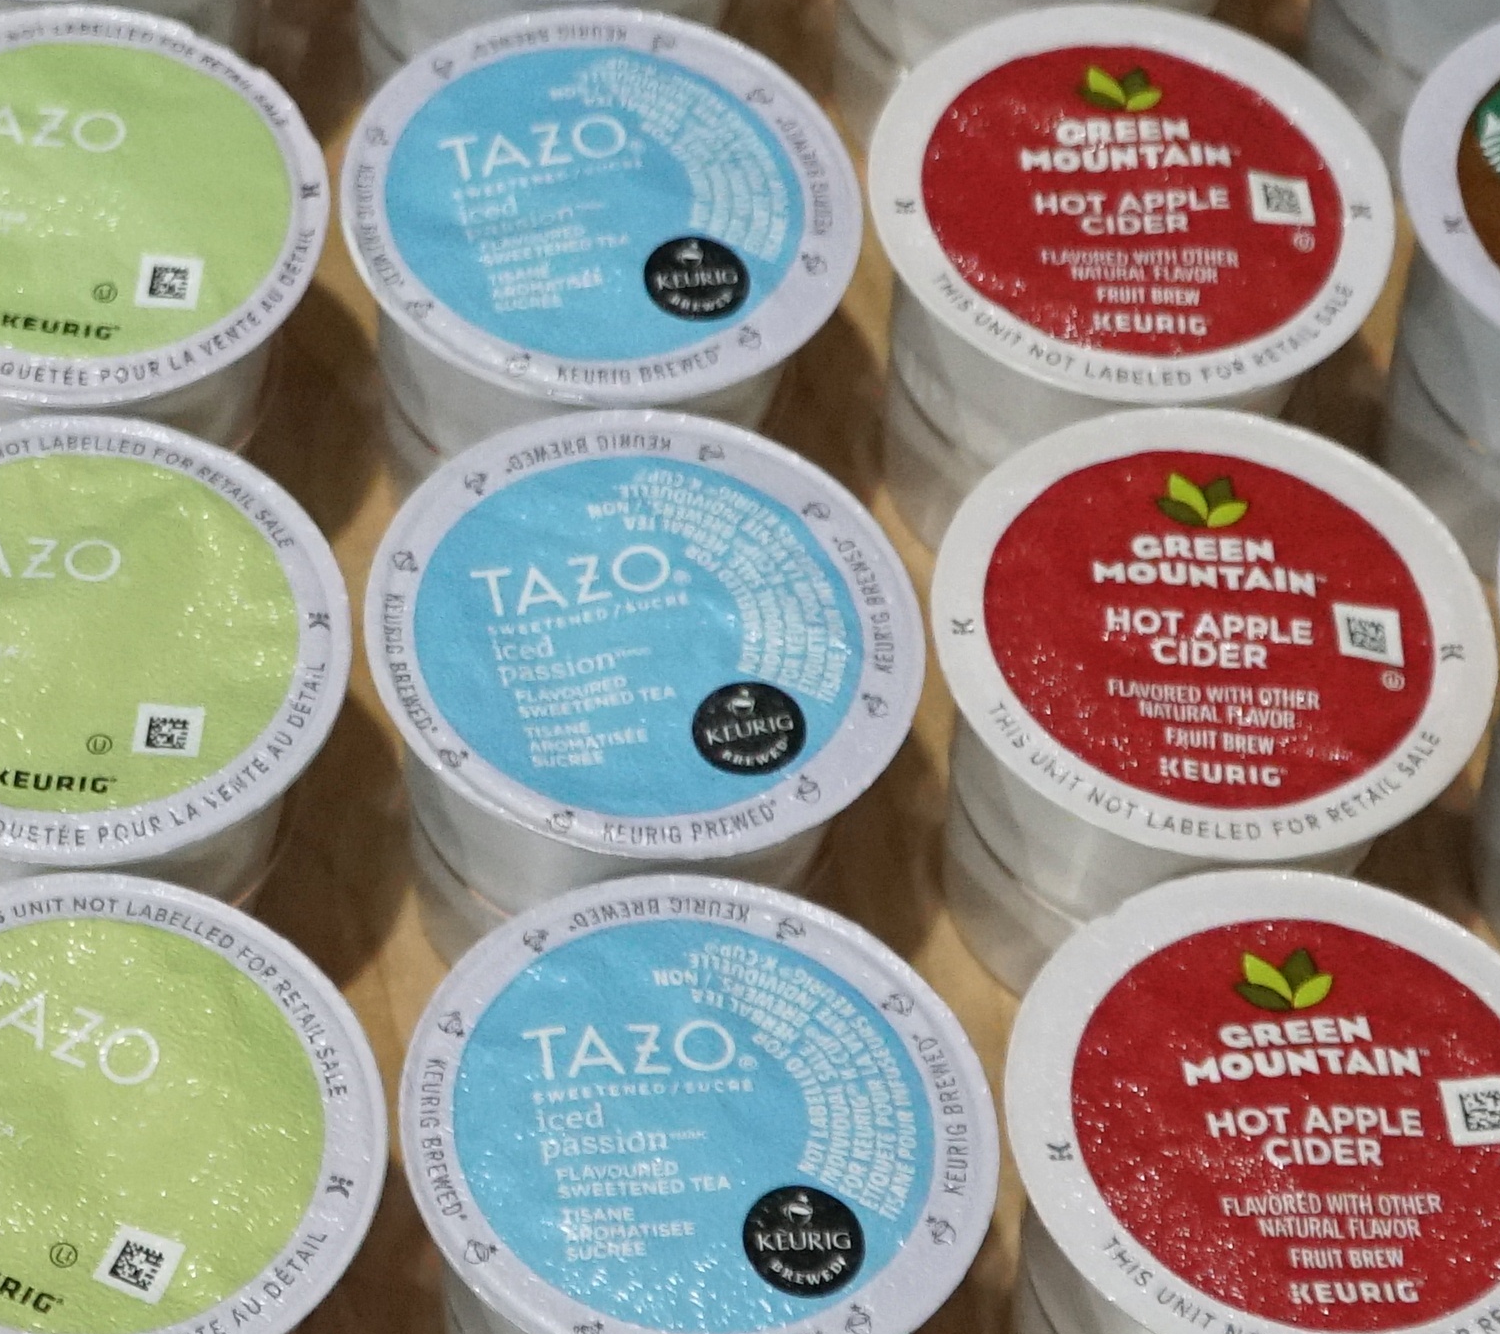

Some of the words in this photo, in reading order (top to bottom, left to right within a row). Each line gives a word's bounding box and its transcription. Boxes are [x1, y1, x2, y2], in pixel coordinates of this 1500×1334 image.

[439, 113, 628, 179] TAZO
[1033, 188, 1112, 217] HOT
[1121, 184, 1231, 214] APPLE
[1081, 209, 1190, 236] CIDER
[470, 547, 672, 620] TAZO
[1104, 606, 1186, 639] HOT
[1195, 609, 1313, 646] APPLE
[1148, 636, 1268, 670] CIDER
[523, 1019, 736, 1077] TAZO
[1219, 1017, 1372, 1048] GREEN
[1179, 1044, 1421, 1086] MOUNTAIN
[536, 1105, 604, 1134] iced
[1207, 1108, 1295, 1141] HOT
[1303, 1105, 1425, 1141] APPLE
[538, 1127, 672, 1163] passion
[1263, 1137, 1386, 1172] CIDER
[754, 1227, 852, 1255] KEURIG
[1288, 1278, 1419, 1308] KEURIG
